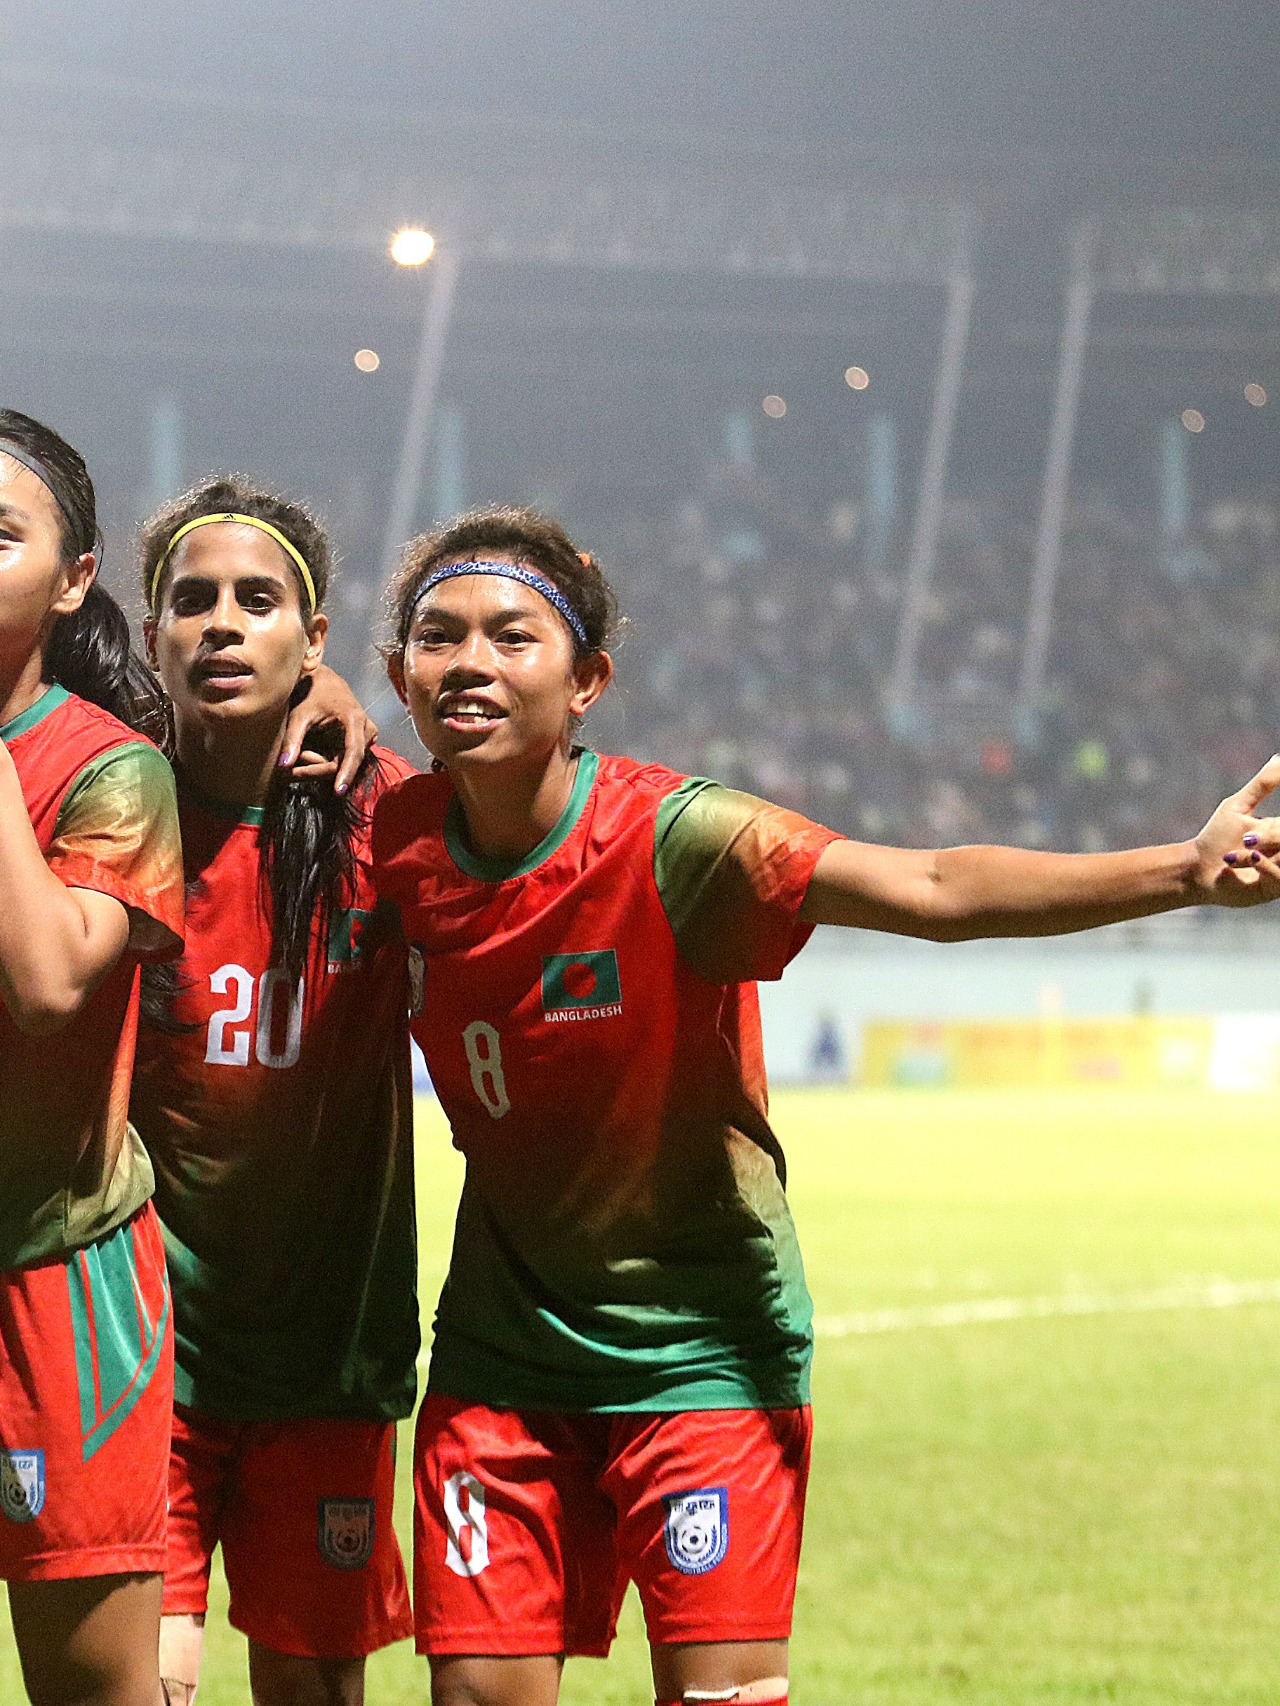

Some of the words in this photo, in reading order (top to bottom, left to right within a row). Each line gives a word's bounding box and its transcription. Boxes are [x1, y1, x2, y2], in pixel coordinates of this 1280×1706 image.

[203, 963, 304, 1069] 20
[544, 1005, 622, 1022] BANGLADESH
[461, 1020, 511, 1119] 8
[443, 1471, 490, 1578] 8
